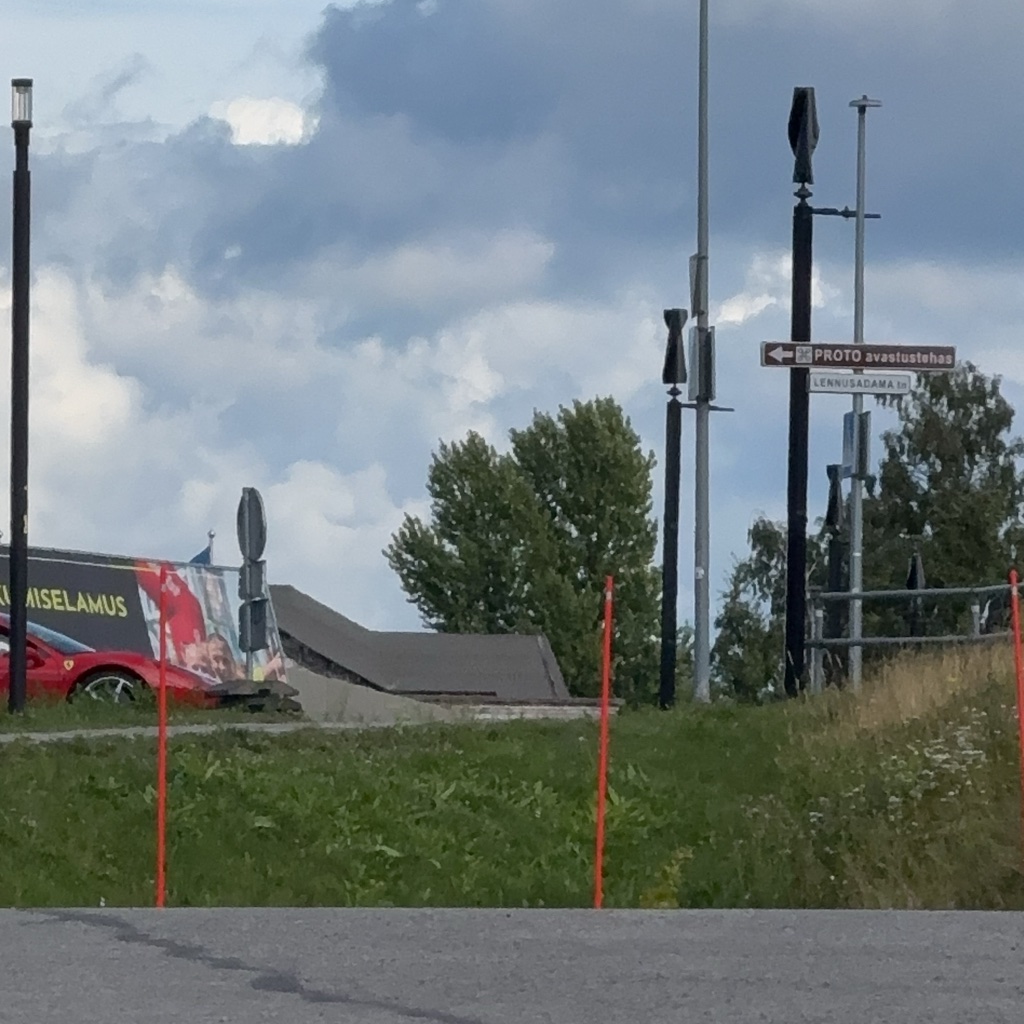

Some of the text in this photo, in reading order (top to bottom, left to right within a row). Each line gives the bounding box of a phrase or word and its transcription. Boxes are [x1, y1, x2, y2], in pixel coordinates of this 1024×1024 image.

[814, 349, 953, 365] PROTO avastustehas
[813, 377, 894, 390] LENNUSADAMA
